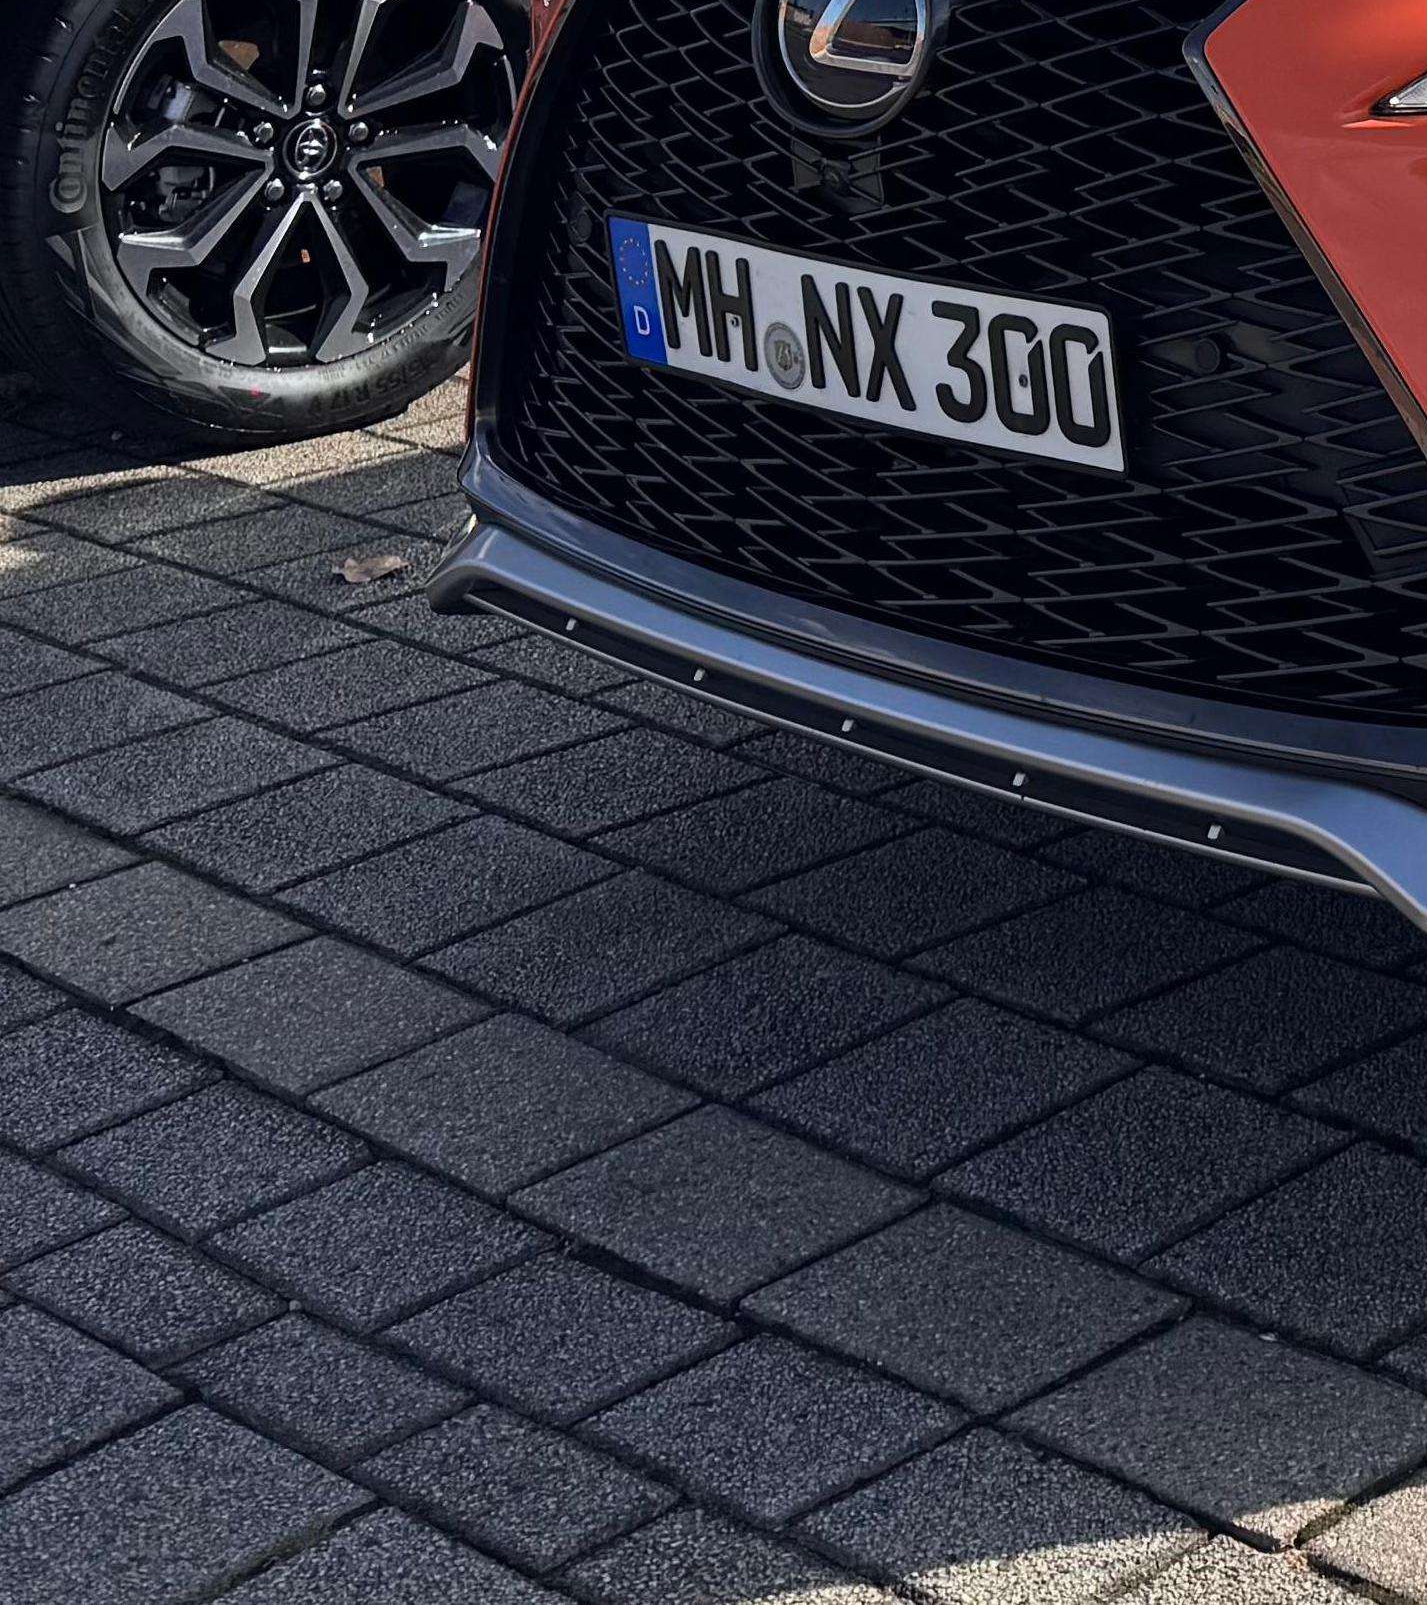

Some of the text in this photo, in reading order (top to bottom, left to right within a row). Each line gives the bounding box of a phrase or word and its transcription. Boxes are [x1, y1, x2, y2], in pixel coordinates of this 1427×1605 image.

[633, 239, 1112, 448] D MH NX 300
